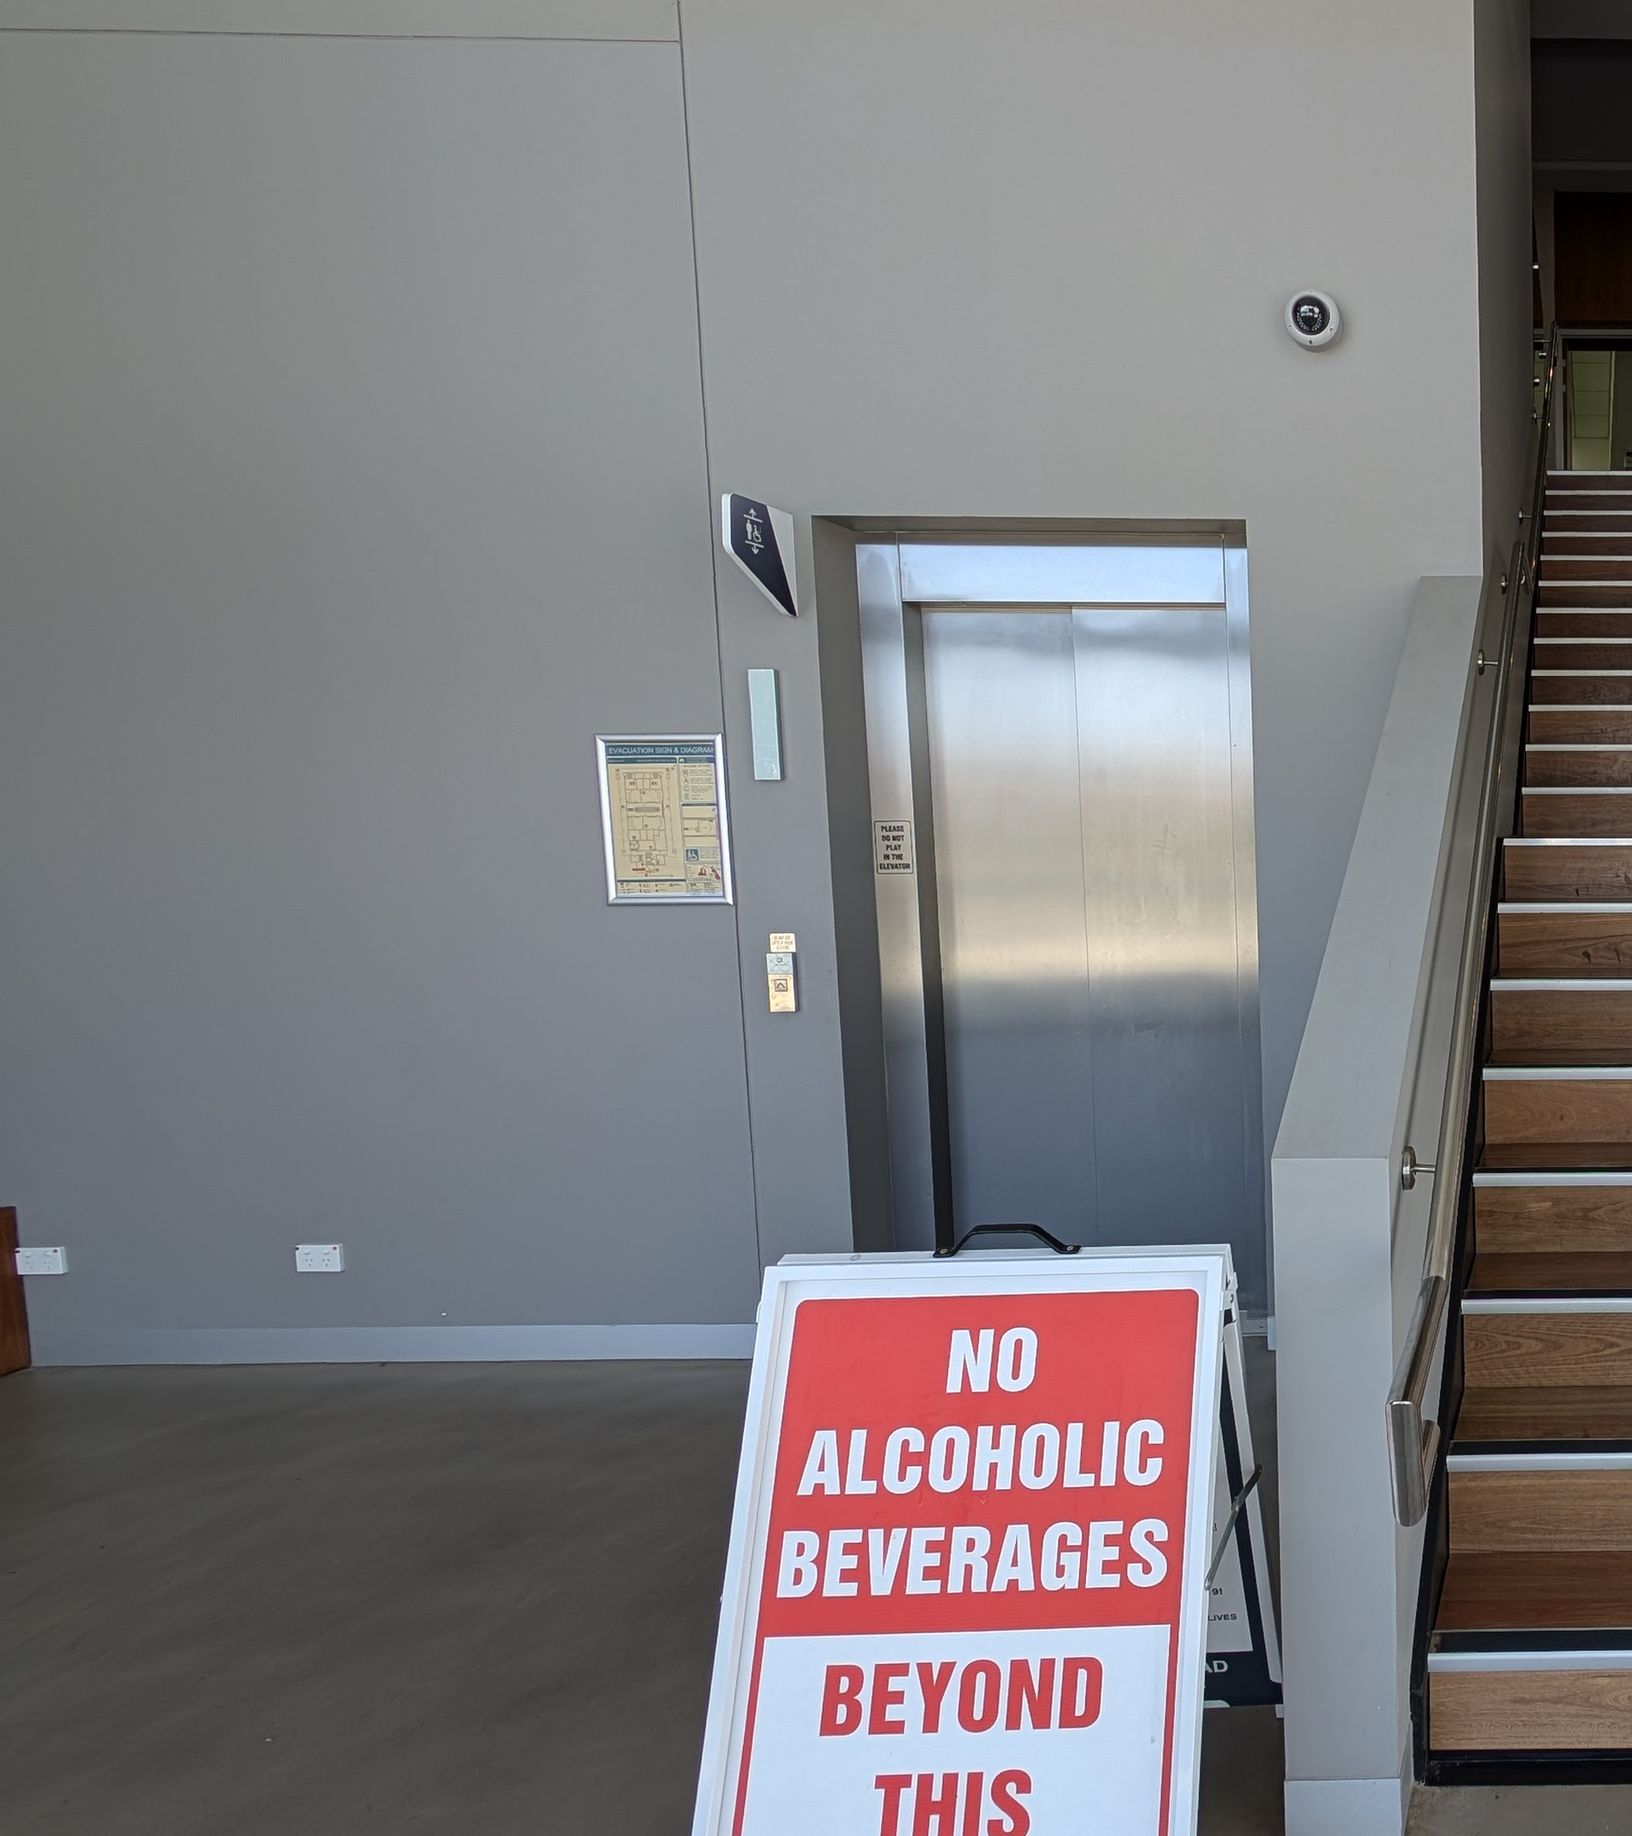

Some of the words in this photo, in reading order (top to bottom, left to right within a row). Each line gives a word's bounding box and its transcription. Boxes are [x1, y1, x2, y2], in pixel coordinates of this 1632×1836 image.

[945, 1326, 1039, 1394] NO
[796, 1418, 1165, 1496] ALCOHOLIC
[776, 1518, 1169, 1598] BEVERAGES
[818, 1656, 1104, 1737] BEYOND
[873, 1768, 1033, 1836] THIS
